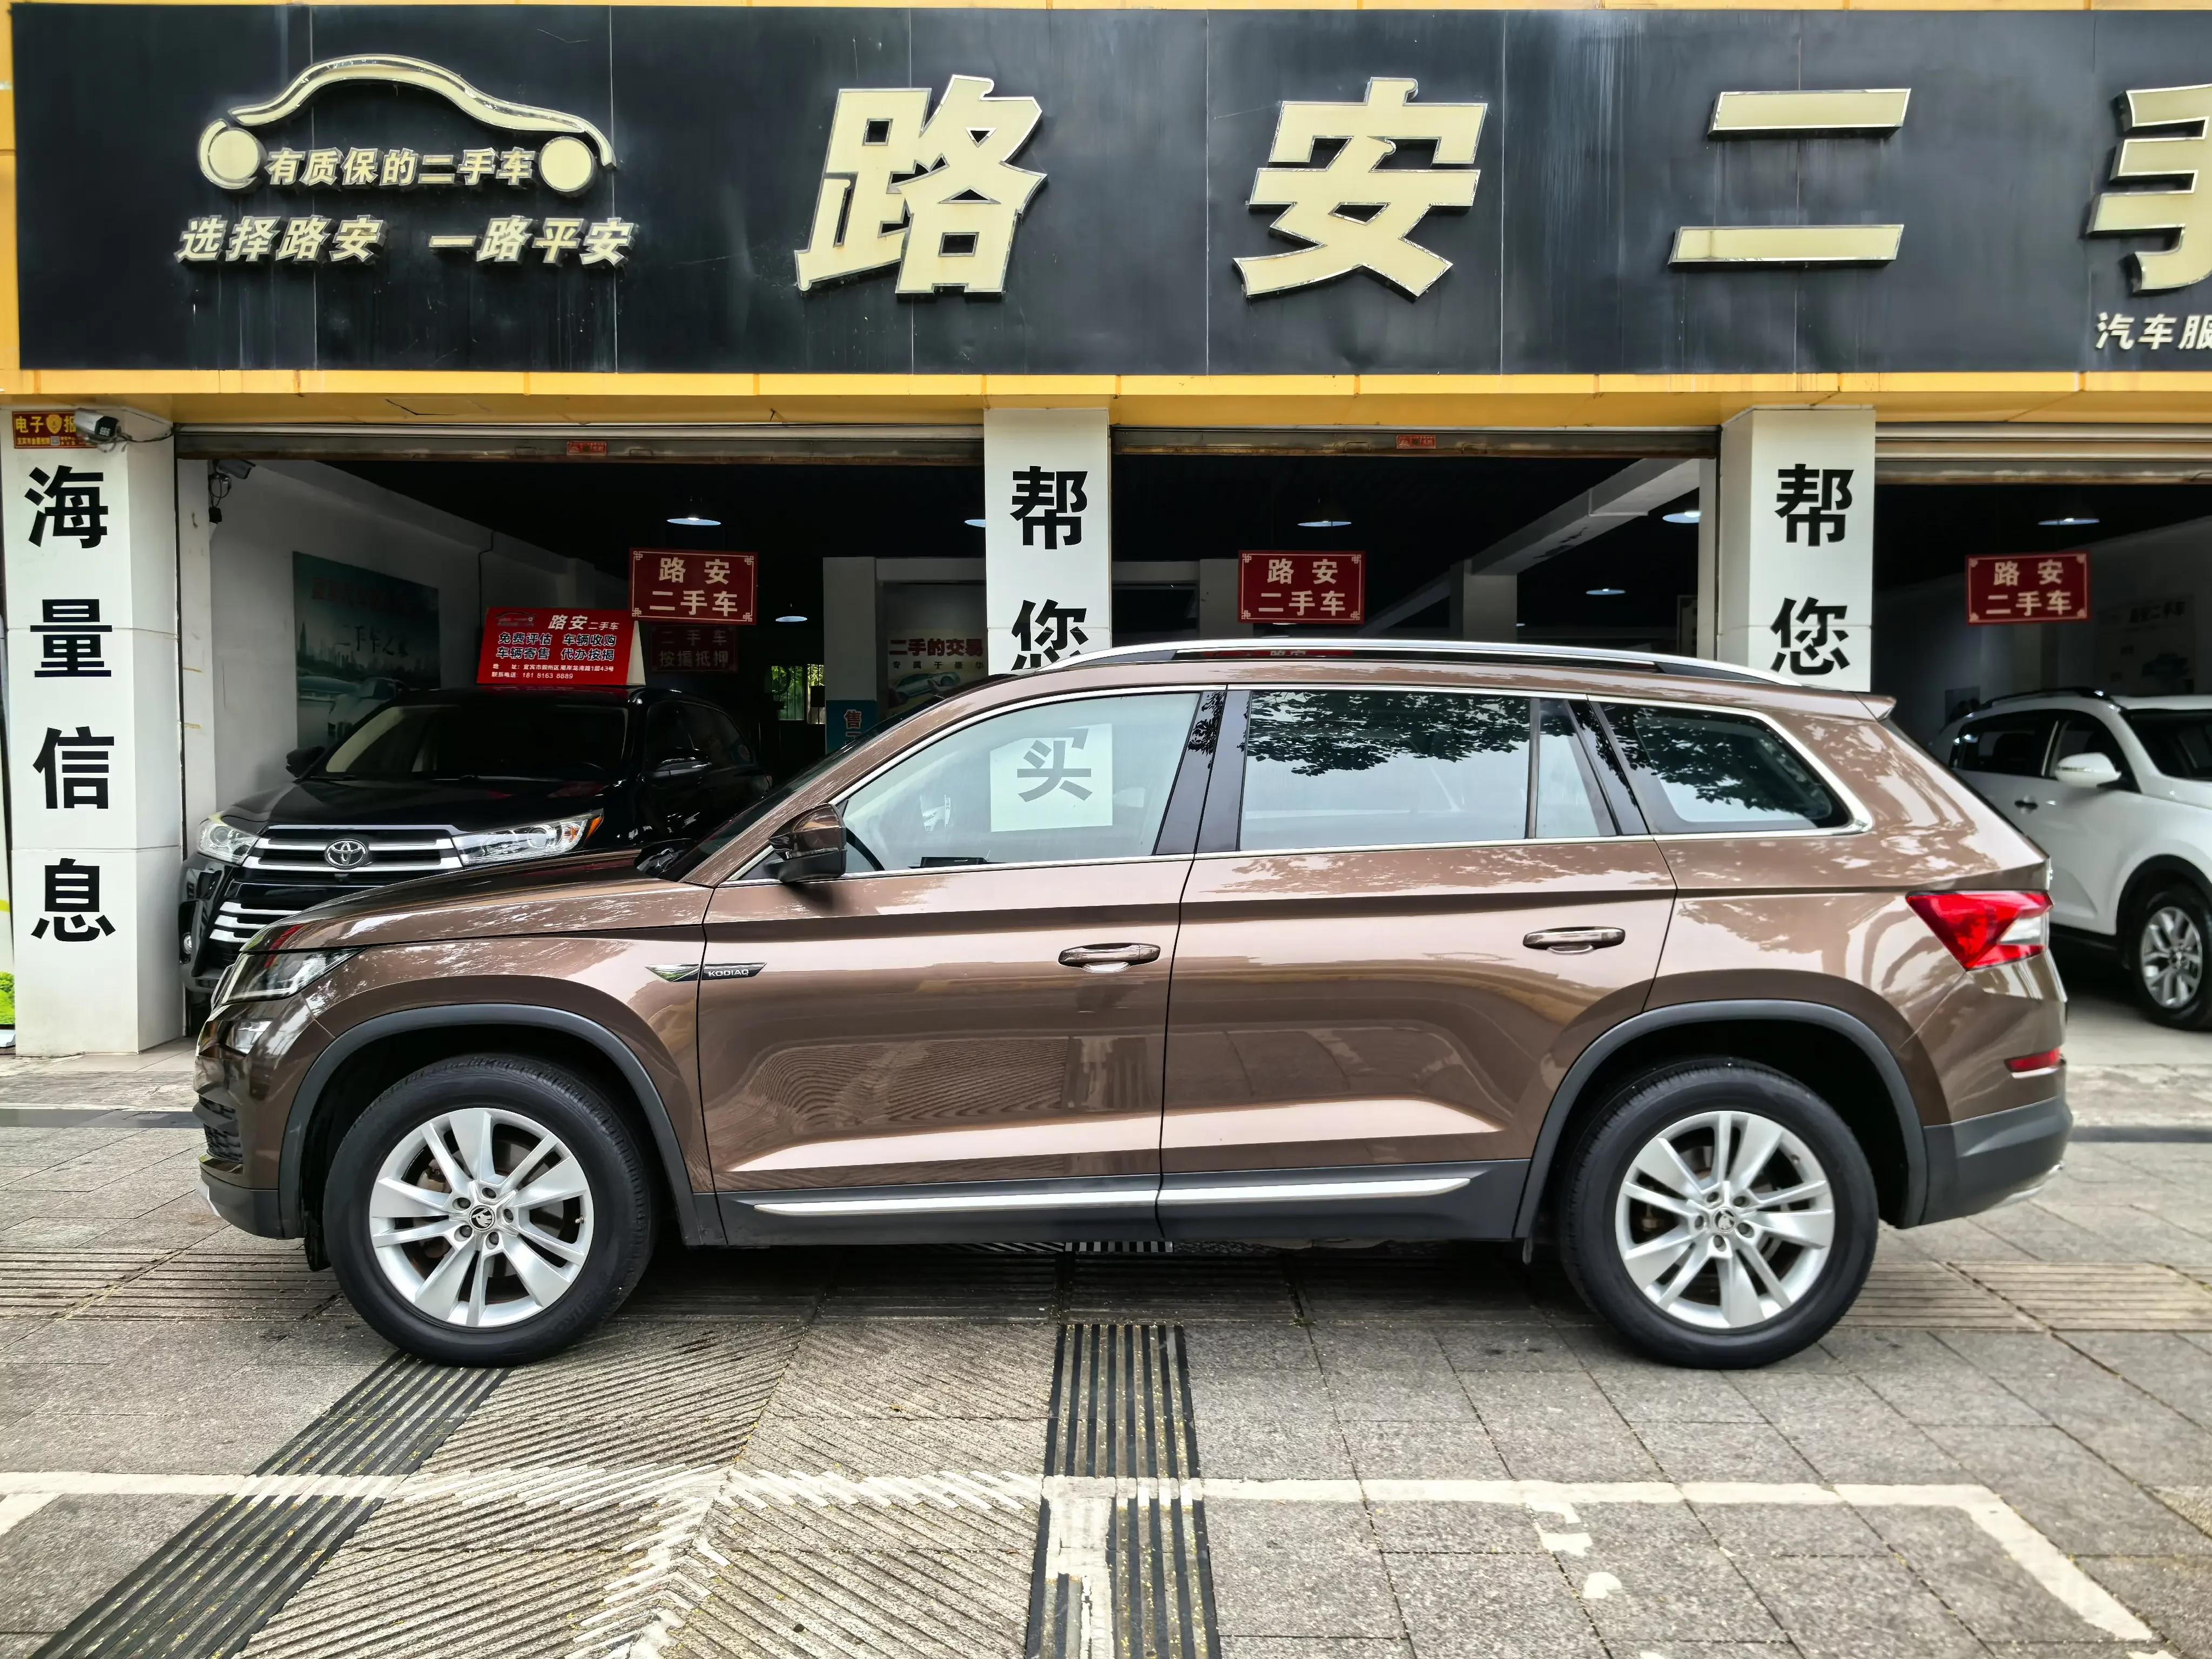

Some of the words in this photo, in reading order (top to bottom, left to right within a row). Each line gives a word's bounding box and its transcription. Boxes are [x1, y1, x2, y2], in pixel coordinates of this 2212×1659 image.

[267, 147, 535, 187] 有质保的二手车
[174, 215, 386, 265] 选择路安
[430, 216, 638, 267] 一路平安
[658, 557, 730, 585] 路安
[1267, 558, 1338, 585] 路安
[1770, 463, 1854, 676] 帮您
[1993, 559, 2063, 586] 路安
[650, 590, 738, 617] 二手车
[1258, 590, 1346, 617] 二手车
[1986, 590, 2072, 617] 二手车
[498, 632, 552, 645] 免费评估
[562, 633, 616, 647] 车辆收购
[660, 629, 727, 646] 二手车
[889, 638, 983, 656] 二手的交易
[496, 646, 550, 660] 车辆寄售
[560, 648, 615, 661] 代办按揭
[24, 465, 116, 942] 海量信息
[708, 969, 749, 977] KODIAQ
